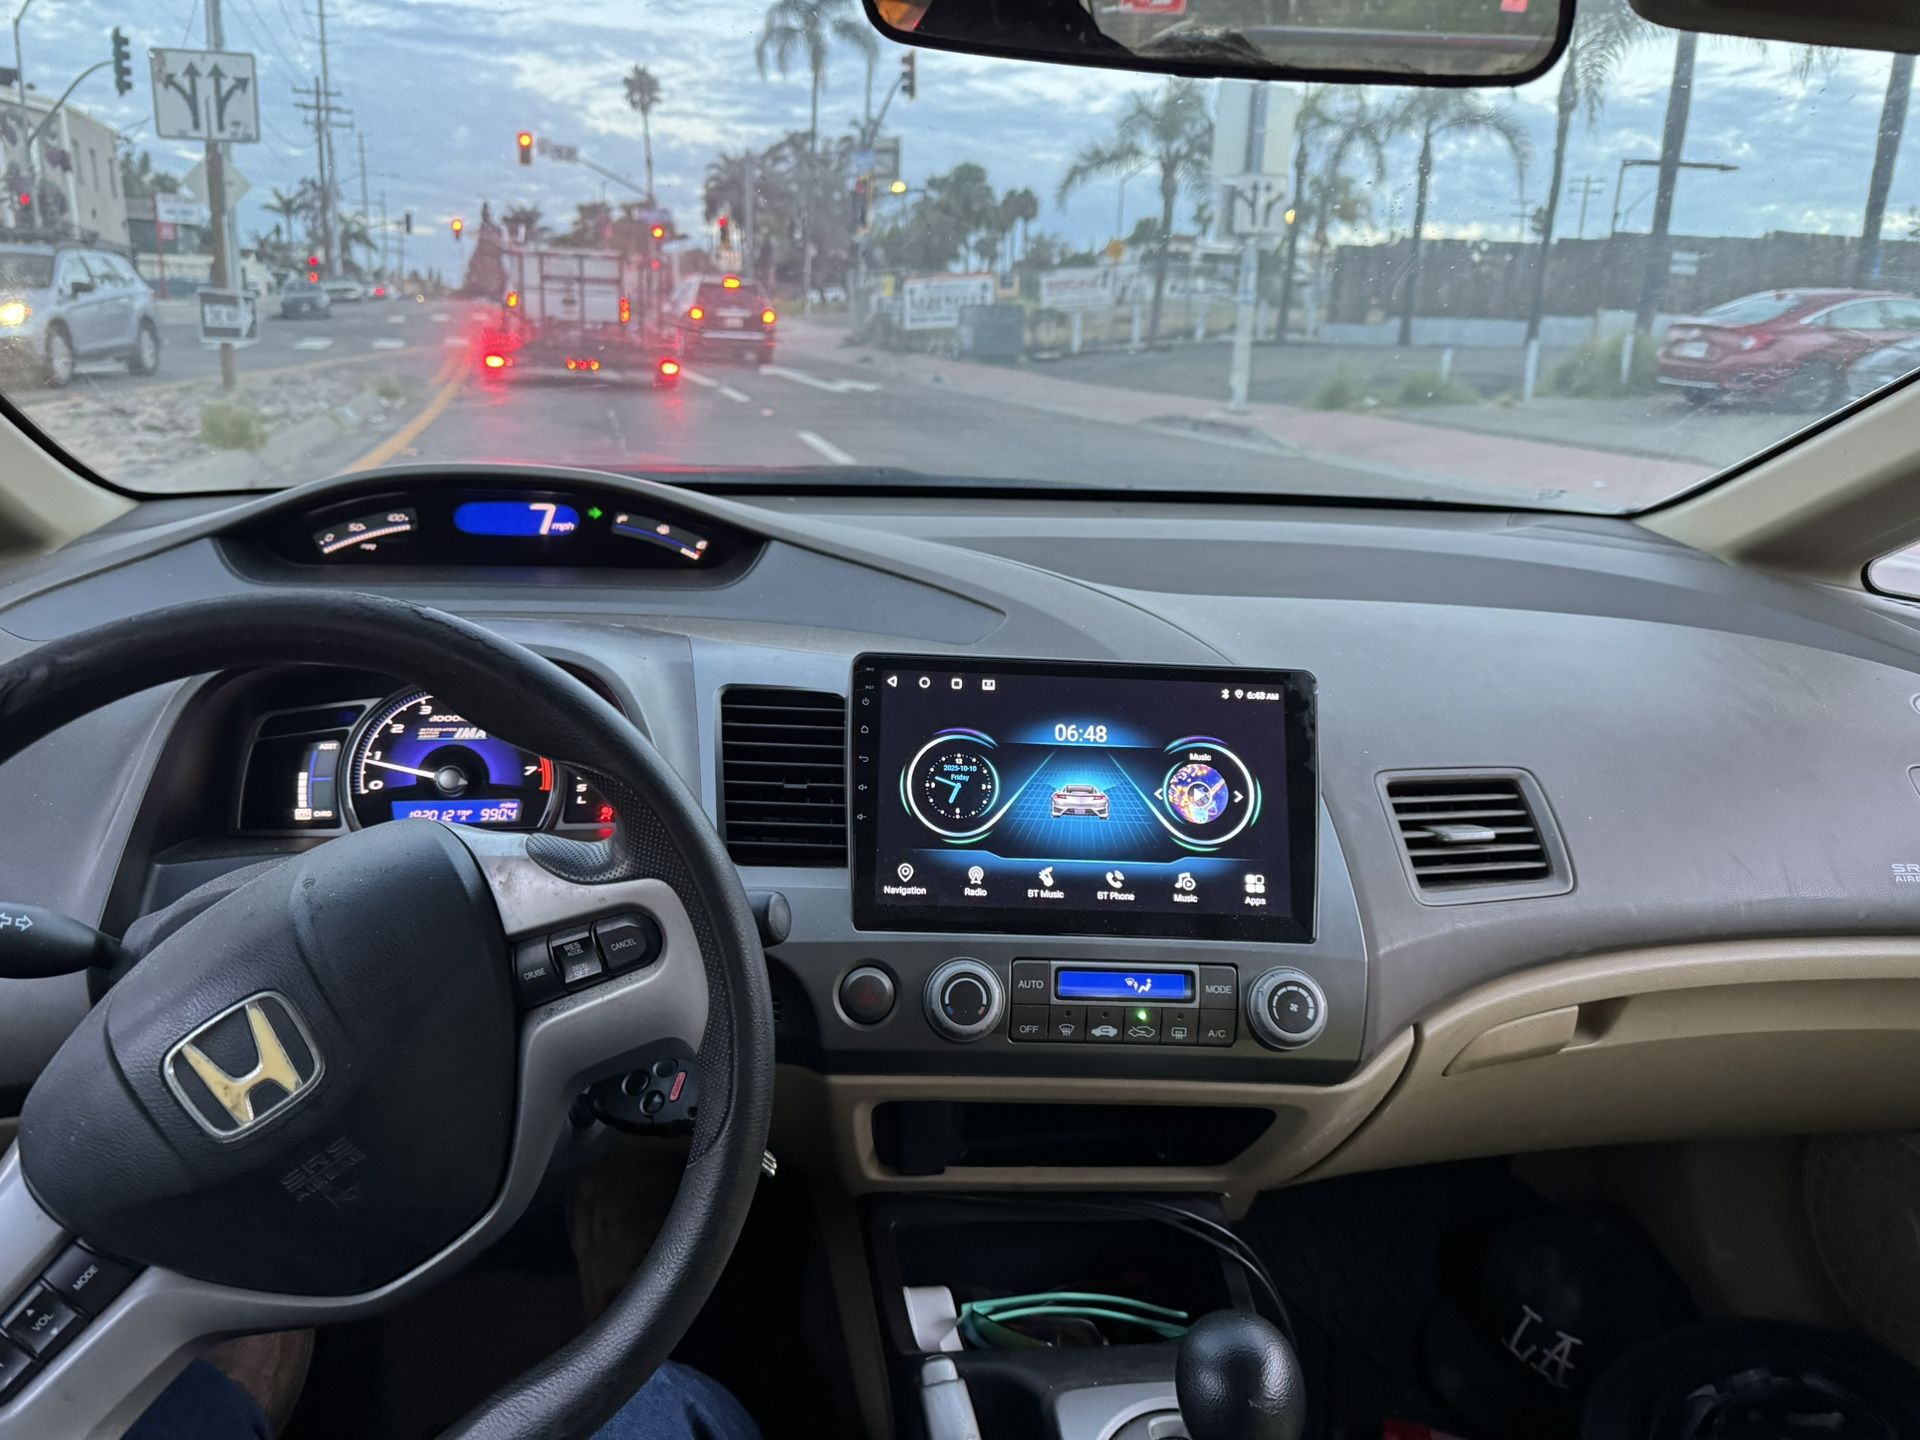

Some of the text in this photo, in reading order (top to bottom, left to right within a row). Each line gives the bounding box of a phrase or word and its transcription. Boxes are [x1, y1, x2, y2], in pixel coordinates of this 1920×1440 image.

[529, 503, 575, 535] 7 mph
[1246, 691, 1279, 701] 6:48 AM
[419, 705, 432, 715] 3
[390, 724, 405, 734] 2
[1054, 723, 1108, 743] 06:48
[374, 751, 382, 761] 1
[1189, 753, 1212, 762] Music
[524, 766, 538, 776] 7
[943, 764, 977, 772] 2025-10-10
[951, 774, 970, 782] Friday
[368, 780, 384, 790] 0
[1891, 863, 1920, 873] SR
[883, 885, 927, 896] Navigation
[964, 887, 988, 897] Radio
[1027, 889, 1065, 899] BT Music
[1097, 891, 1135, 902] BT Phone
[1173, 893, 1198, 903] Music
[1244, 896, 1267, 906] Apps
[563, 942, 581, 952] RES
[610, 938, 637, 951] CANCEL
[523, 967, 546, 980] CRUISE
[1017, 979, 1044, 989] AUTO
[1205, 984, 1233, 995] MODE
[1019, 1024, 1039, 1034] OFF
[1207, 1028, 1226, 1039] A/C
[72, 1264, 99, 1291] MODE
[31, 1313, 55, 1332] VOL
[1502, 1304, 1583, 1389] LA
